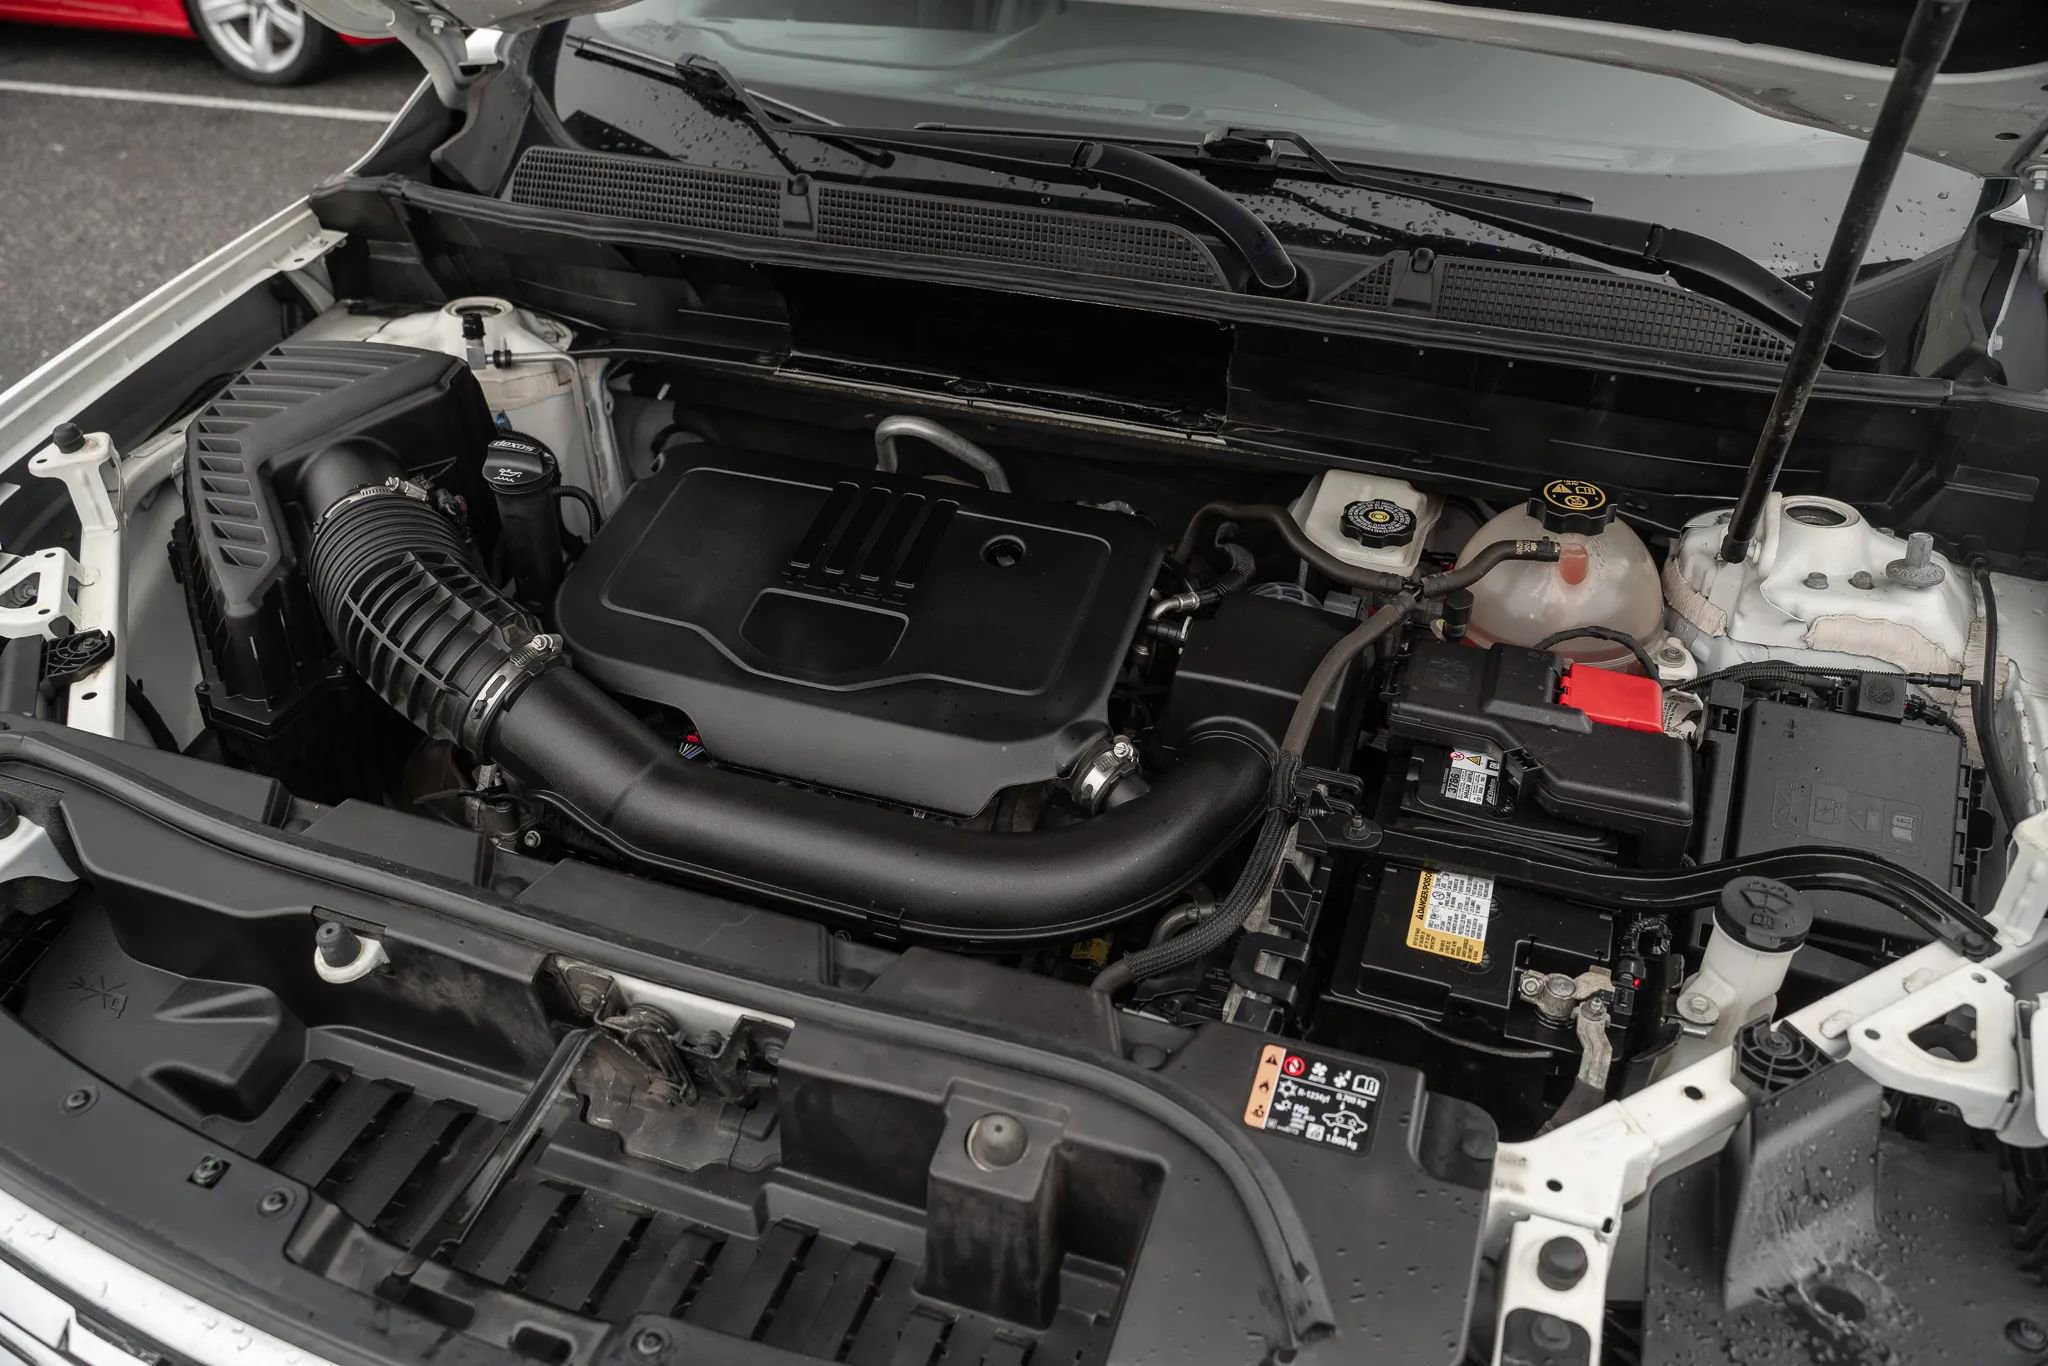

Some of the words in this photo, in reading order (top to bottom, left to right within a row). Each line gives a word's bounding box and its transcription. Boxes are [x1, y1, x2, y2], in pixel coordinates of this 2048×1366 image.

[493, 440, 536, 452] dexos
[1448, 773, 1459, 794] 3786
[1418, 870, 1433, 913] DANGER/POISO
